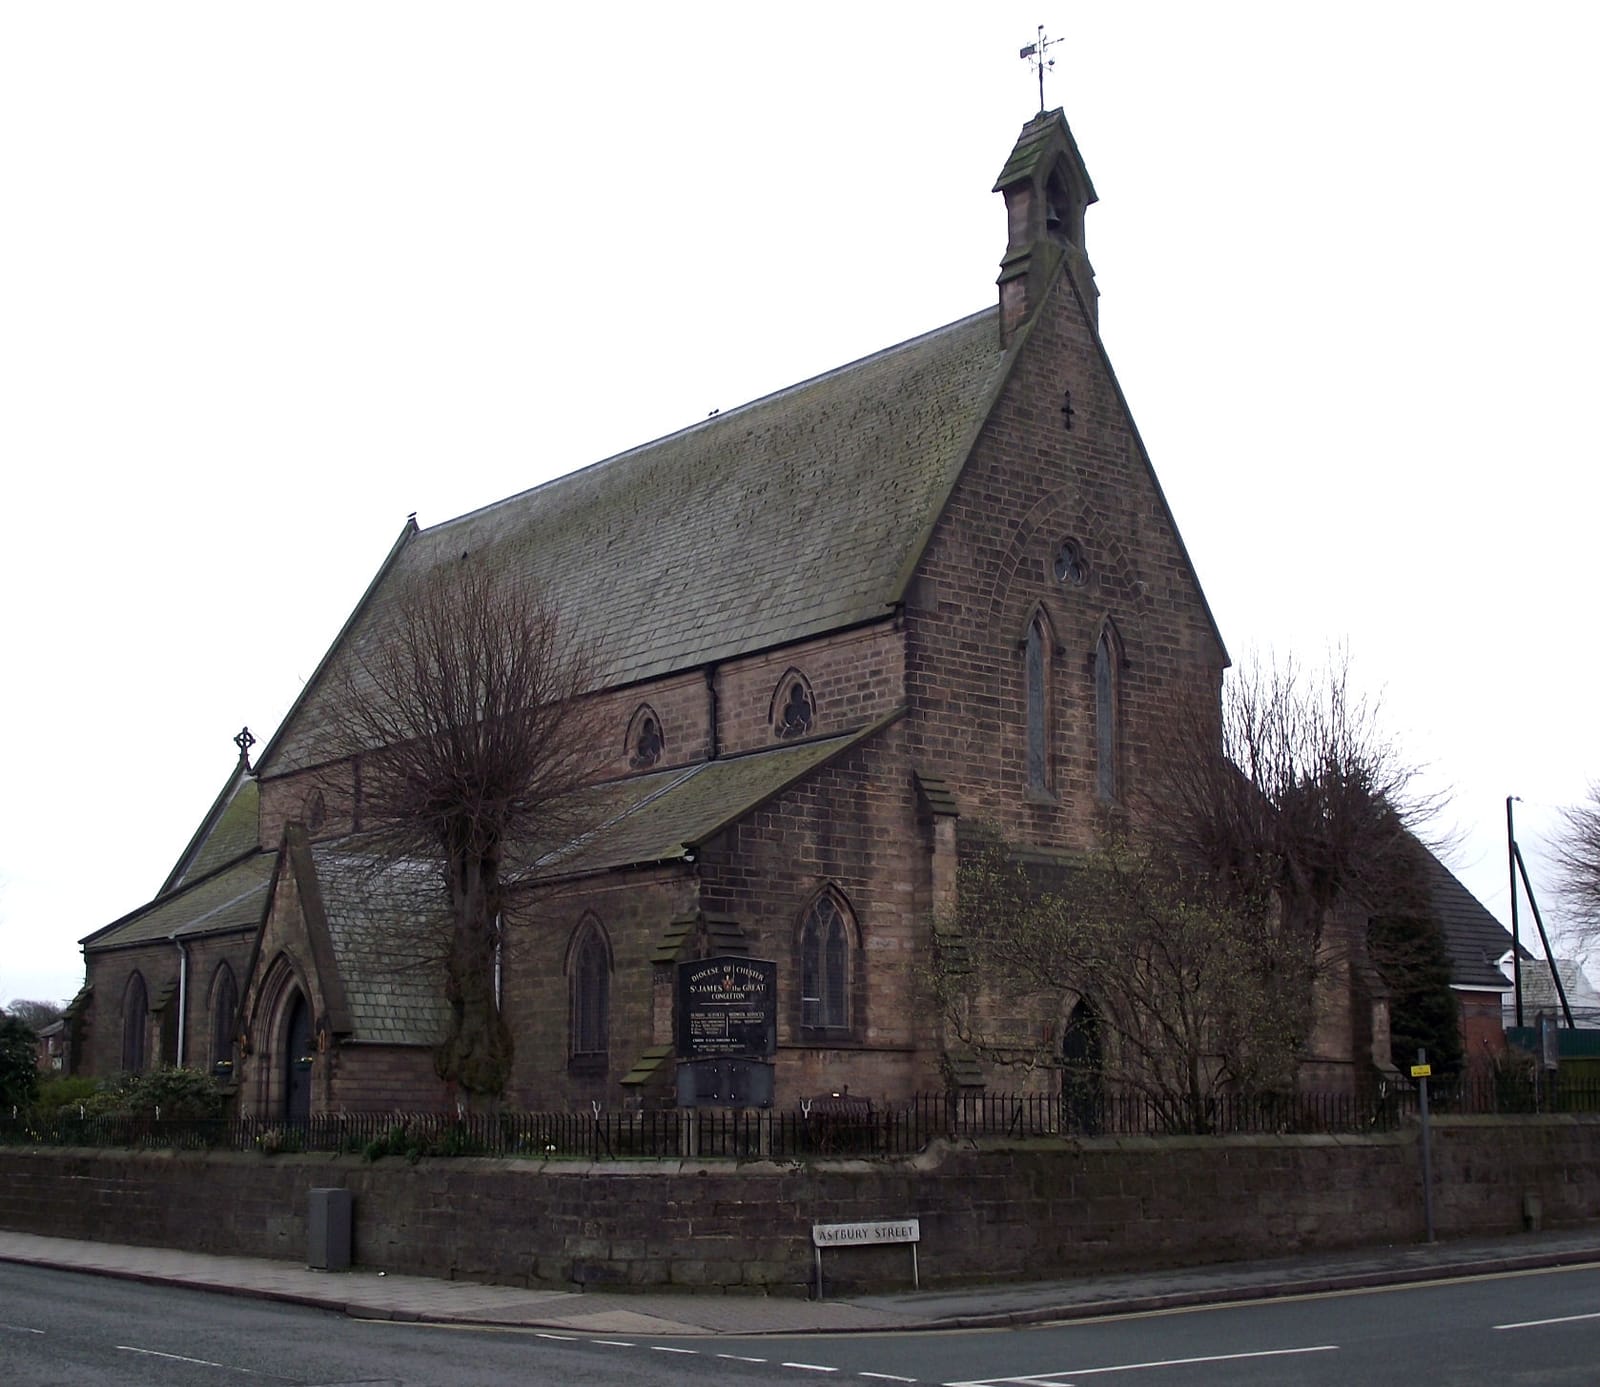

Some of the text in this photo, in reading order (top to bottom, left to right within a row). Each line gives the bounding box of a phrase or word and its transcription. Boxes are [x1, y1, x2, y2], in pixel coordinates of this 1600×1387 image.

[691, 965, 765, 982] DIOCESE OF CHESTER
[697, 984, 723, 993] JAMES
[742, 984, 765, 992] GREAT
[819, 1226, 914, 1241] ASTBURY STREET
